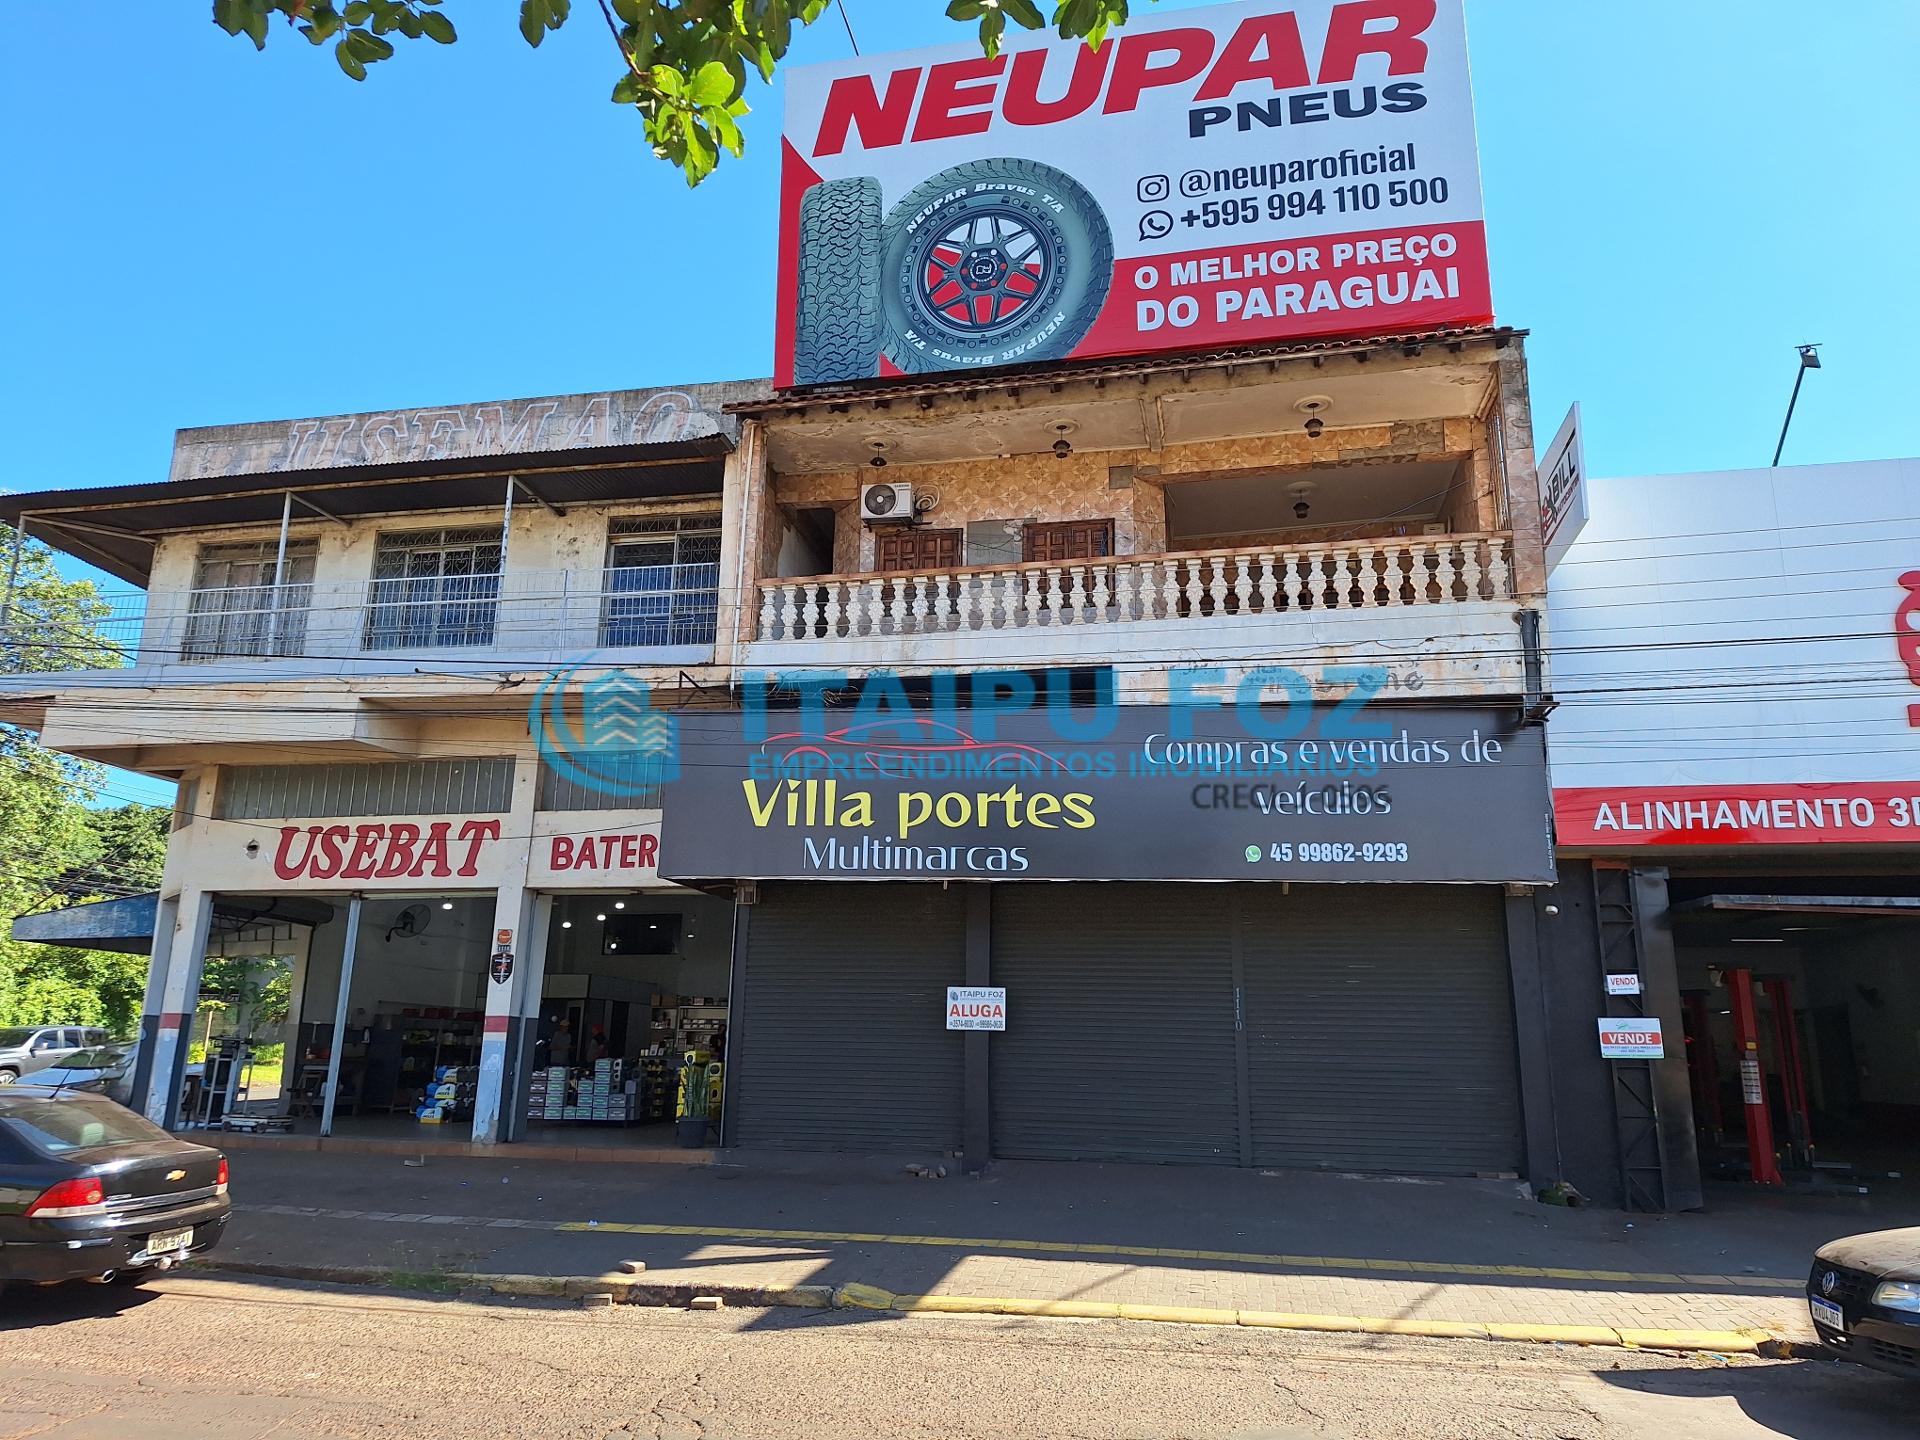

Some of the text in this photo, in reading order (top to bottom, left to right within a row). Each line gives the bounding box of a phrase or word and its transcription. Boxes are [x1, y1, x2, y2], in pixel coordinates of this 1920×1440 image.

[812, 0, 1437, 158] NEUPAR
[1189, 82, 1427, 138] PNEUS
[1179, 143, 1416, 198] @neuparoficial
[906, 183, 1066, 235] NEUPAR Bravus T/A
[1180, 176, 1449, 229] +595 994 110 500
[1134, 232, 1457, 291] O MELHOR PREÇO
[1136, 266, 1460, 332] DO PARAGUAI
[931, 348, 995, 365] Bravus
[1001, 311, 1066, 366] NEUPAR
[1552, 452, 1576, 504] BILL
[1144, 729, 1502, 772] Compras e vendas de
[742, 778, 1096, 839] Villa portes
[1256, 780, 1392, 815] veículos
[1593, 797, 1875, 830] ALINHAMENTO
[273, 819, 501, 881] USEBAT
[550, 834, 658, 871] BATER
[803, 835, 1029, 871] Multimarcas
[1270, 842, 1408, 862] 45 99862-9293
[1610, 977, 1636, 986] VENDO
[950, 1004, 1003, 1017] ALUGA
[1608, 1033, 1653, 1044] VENDE
